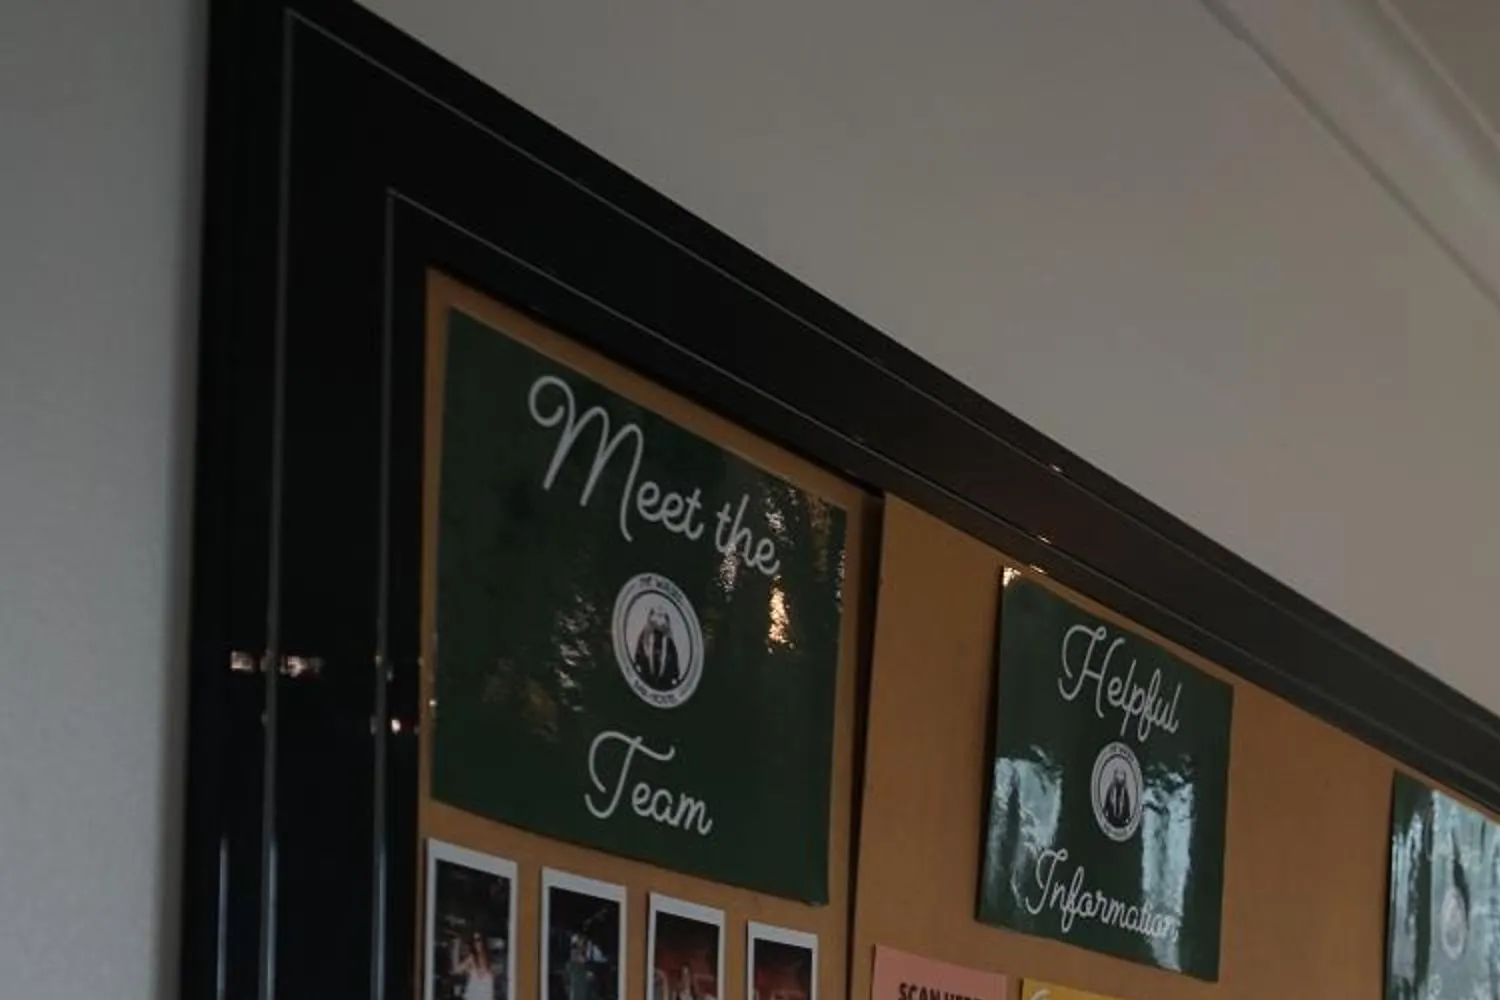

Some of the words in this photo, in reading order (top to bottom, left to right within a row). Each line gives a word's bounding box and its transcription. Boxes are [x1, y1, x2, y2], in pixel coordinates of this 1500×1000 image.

[529, 375, 704, 543] Meet
[715, 494, 781, 576] the
[1058, 624, 1182, 742] Helpful
[585, 731, 713, 837] Team
[1025, 848, 1180, 932] Information
